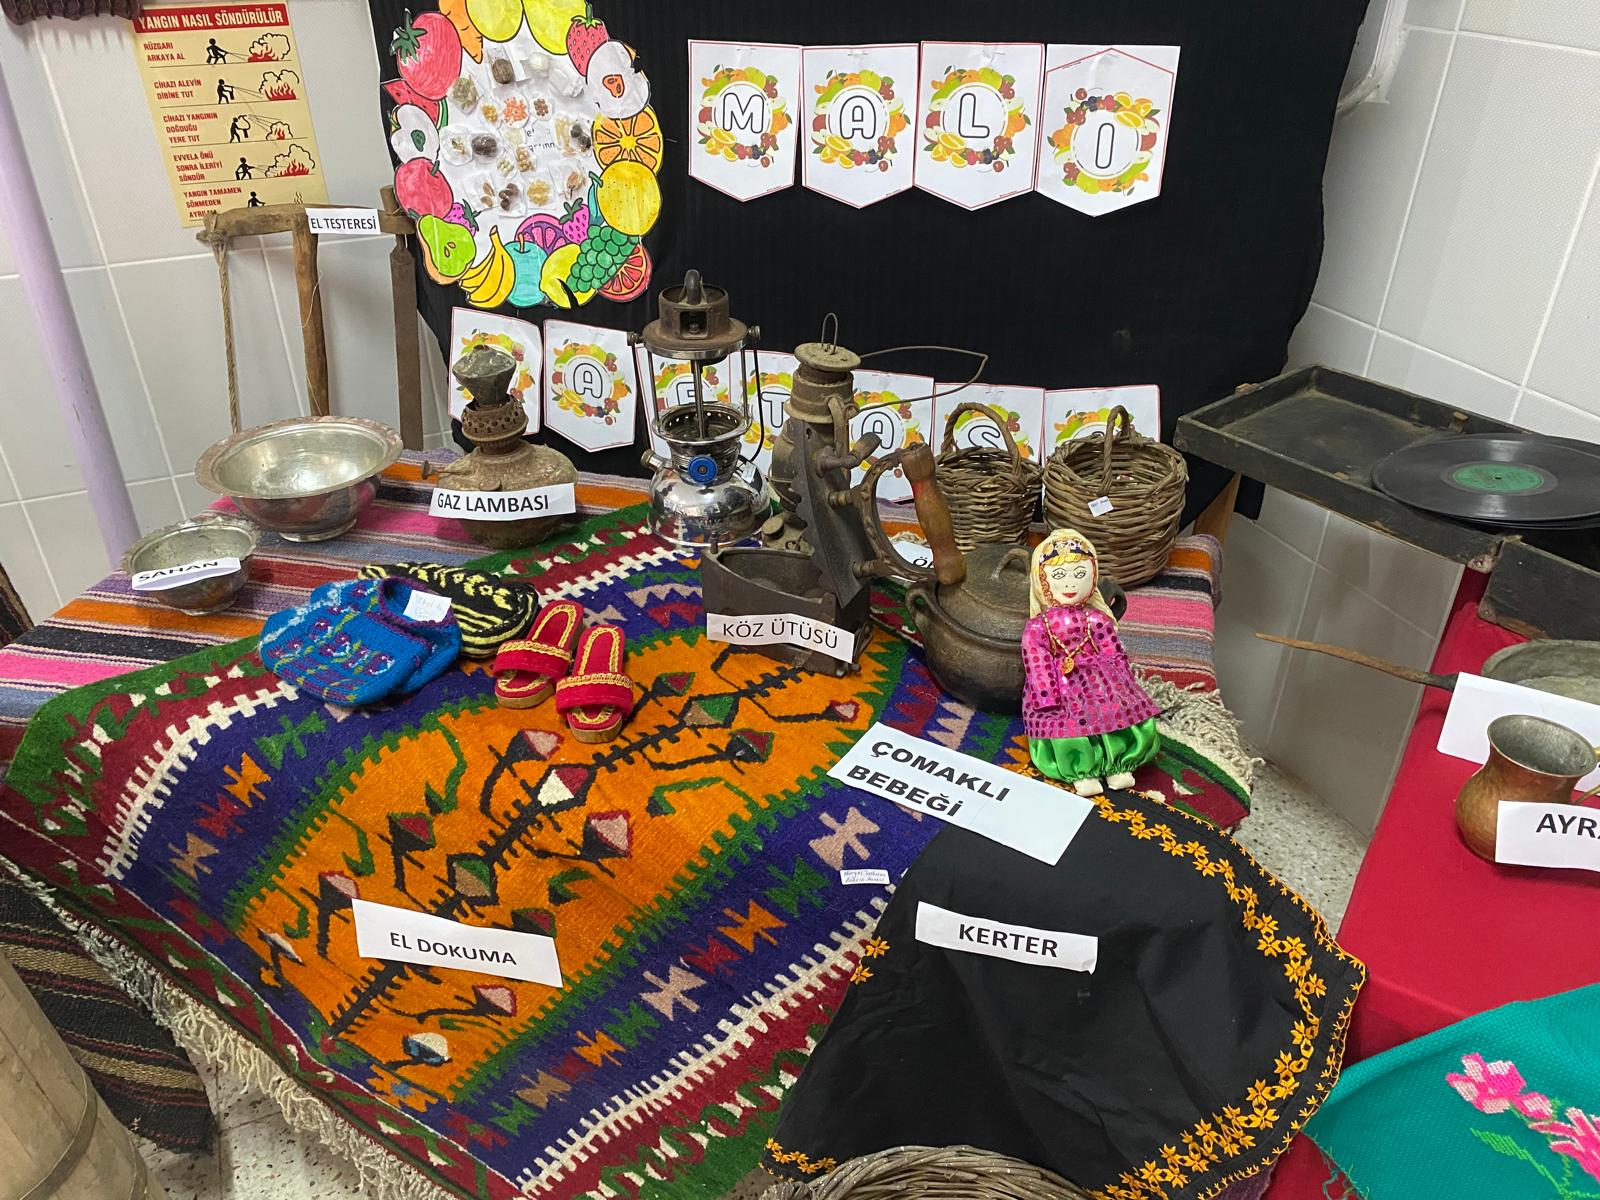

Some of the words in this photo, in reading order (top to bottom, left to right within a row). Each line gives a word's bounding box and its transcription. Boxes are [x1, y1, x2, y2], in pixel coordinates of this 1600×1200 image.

[139, 15, 179, 30] YANGIN
[181, 13, 214, 28] NASIL
[215, 7, 284, 26] SÖNDÜRÜLÜR
[143, 42, 174, 51] RÜZGARI
[147, 54, 175, 62] ARKAYA
[176, 53, 186, 61] AL
[154, 79, 177, 89] CİHAZI
[178, 78, 202, 88] ALEVİN
[157, 91, 181, 100] DİBİNE
[182, 90, 194, 99] TUT
[163, 114, 185, 123] CİHAZI
[187, 112, 218, 121] YANGININ
[166, 124, 198, 134] DOĞDUĞU
[169, 135, 187, 144] YERE
[173, 153, 199, 162] EVVELA
[200, 151, 214, 159] ÖNÜ
[176, 163, 200, 172] SONRA
[200, 161, 223, 170] İLERİYİ
[179, 173, 206, 182] SÖNDÜR
[183, 189, 208, 198] YANGIN
[209, 187, 242, 196] TAMAMEN
[186, 199, 221, 209] SÖNMEDEN
[310, 217, 323, 229] EL
[323, 215, 377, 230] TESTERESİ
[437, 492, 461, 511] GAZ
[466, 494, 549, 513] LAMBASI
[138, 561, 218, 581] SAHAN
[723, 620, 764, 638] KÖZ
[771, 618, 838, 649] ÜTÜSÜ
[870, 741, 1011, 802] ÇOMAKLI
[846, 764, 964, 818] BEBEĞİ
[1535, 813, 1600, 840] AYR
[958, 923, 1059, 958] KERTER
[389, 932, 413, 950] EL
[416, 938, 518, 966] DOKUMA
